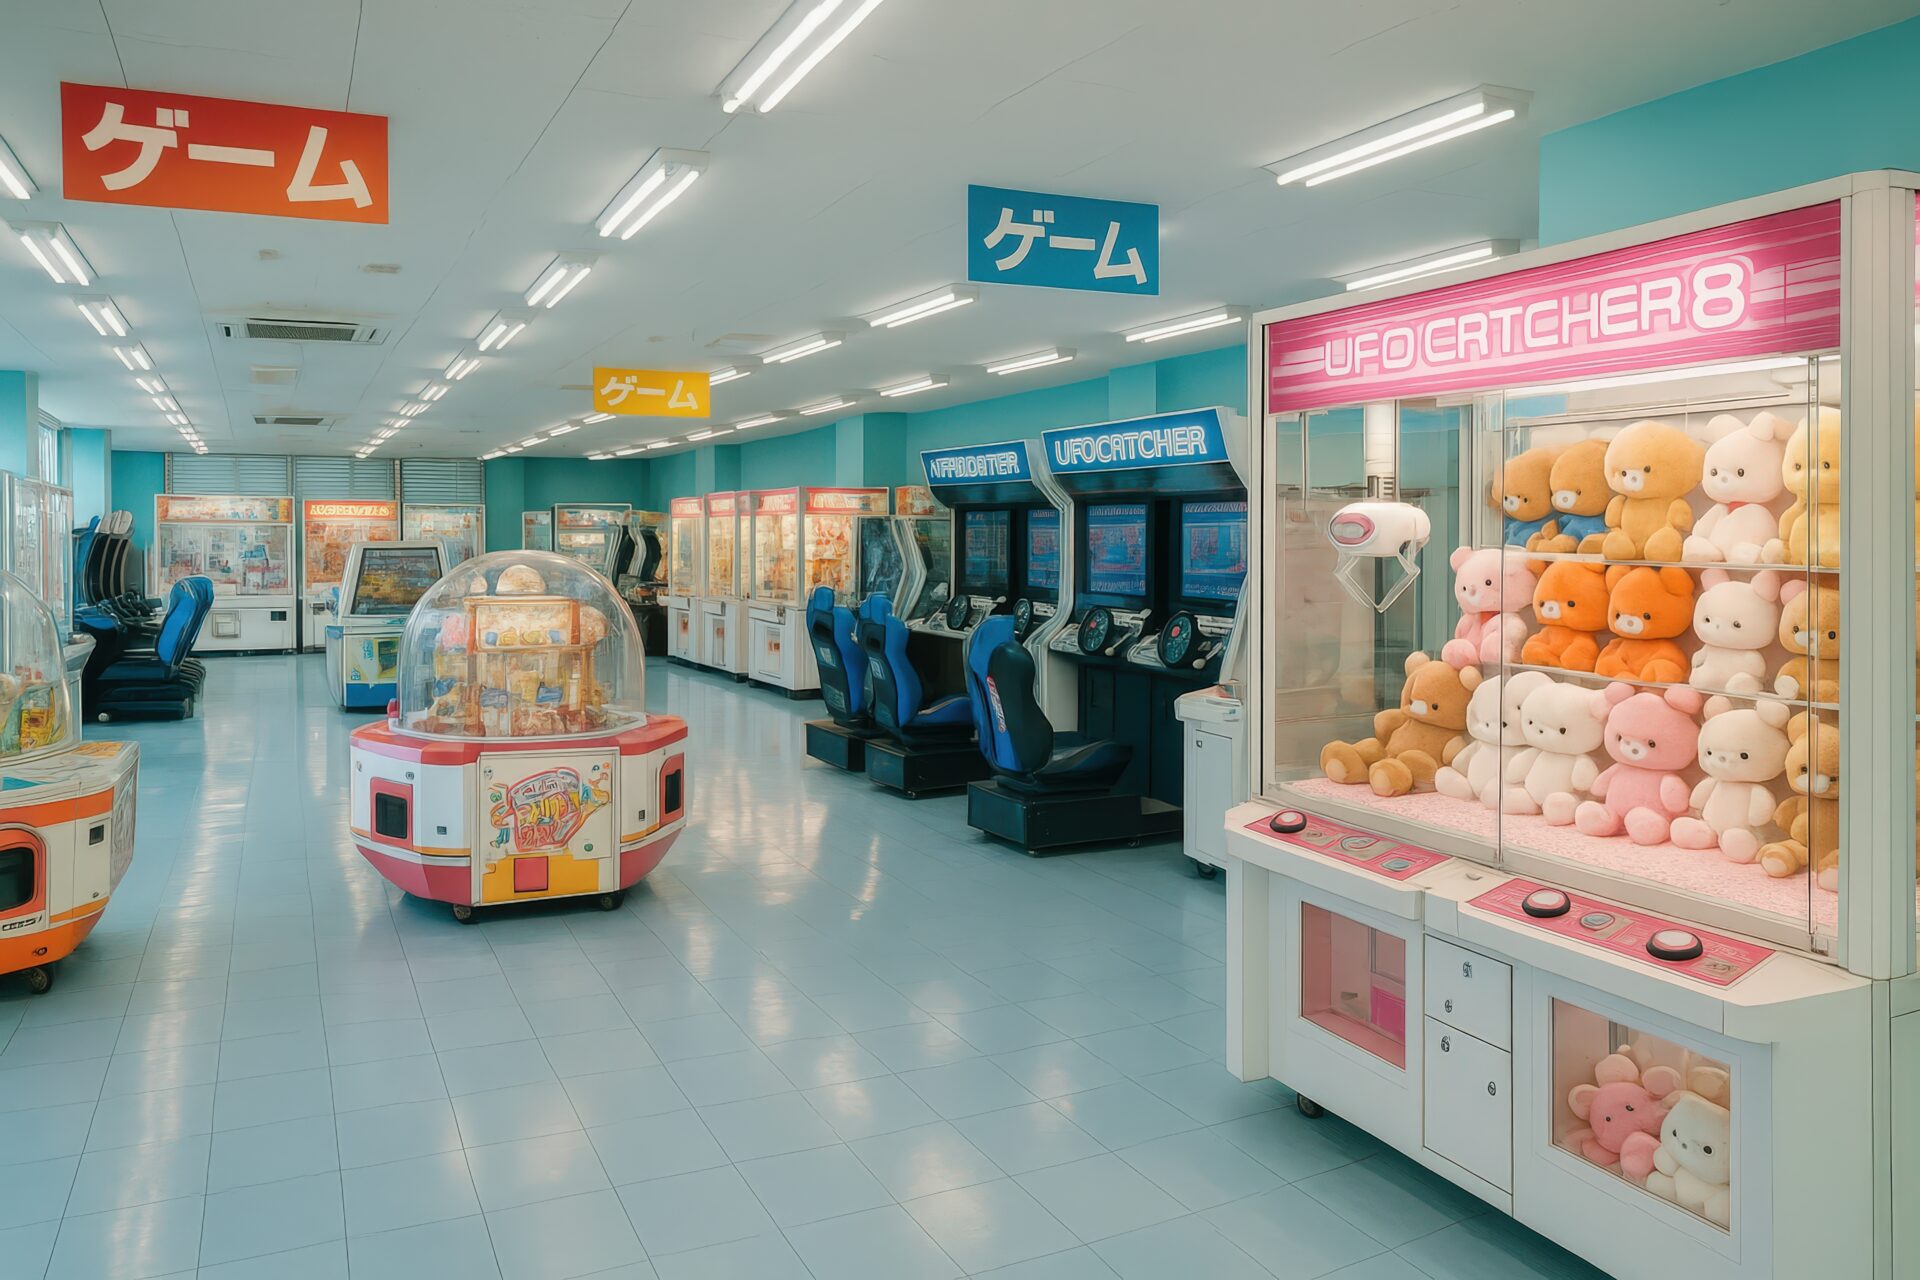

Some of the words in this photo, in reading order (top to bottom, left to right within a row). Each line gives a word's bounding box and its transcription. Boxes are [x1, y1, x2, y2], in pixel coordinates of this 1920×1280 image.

[81, 101, 374, 208] ゲーム
[983, 207, 1148, 285] ゲーム
[600, 375, 698, 410] ゲーム
